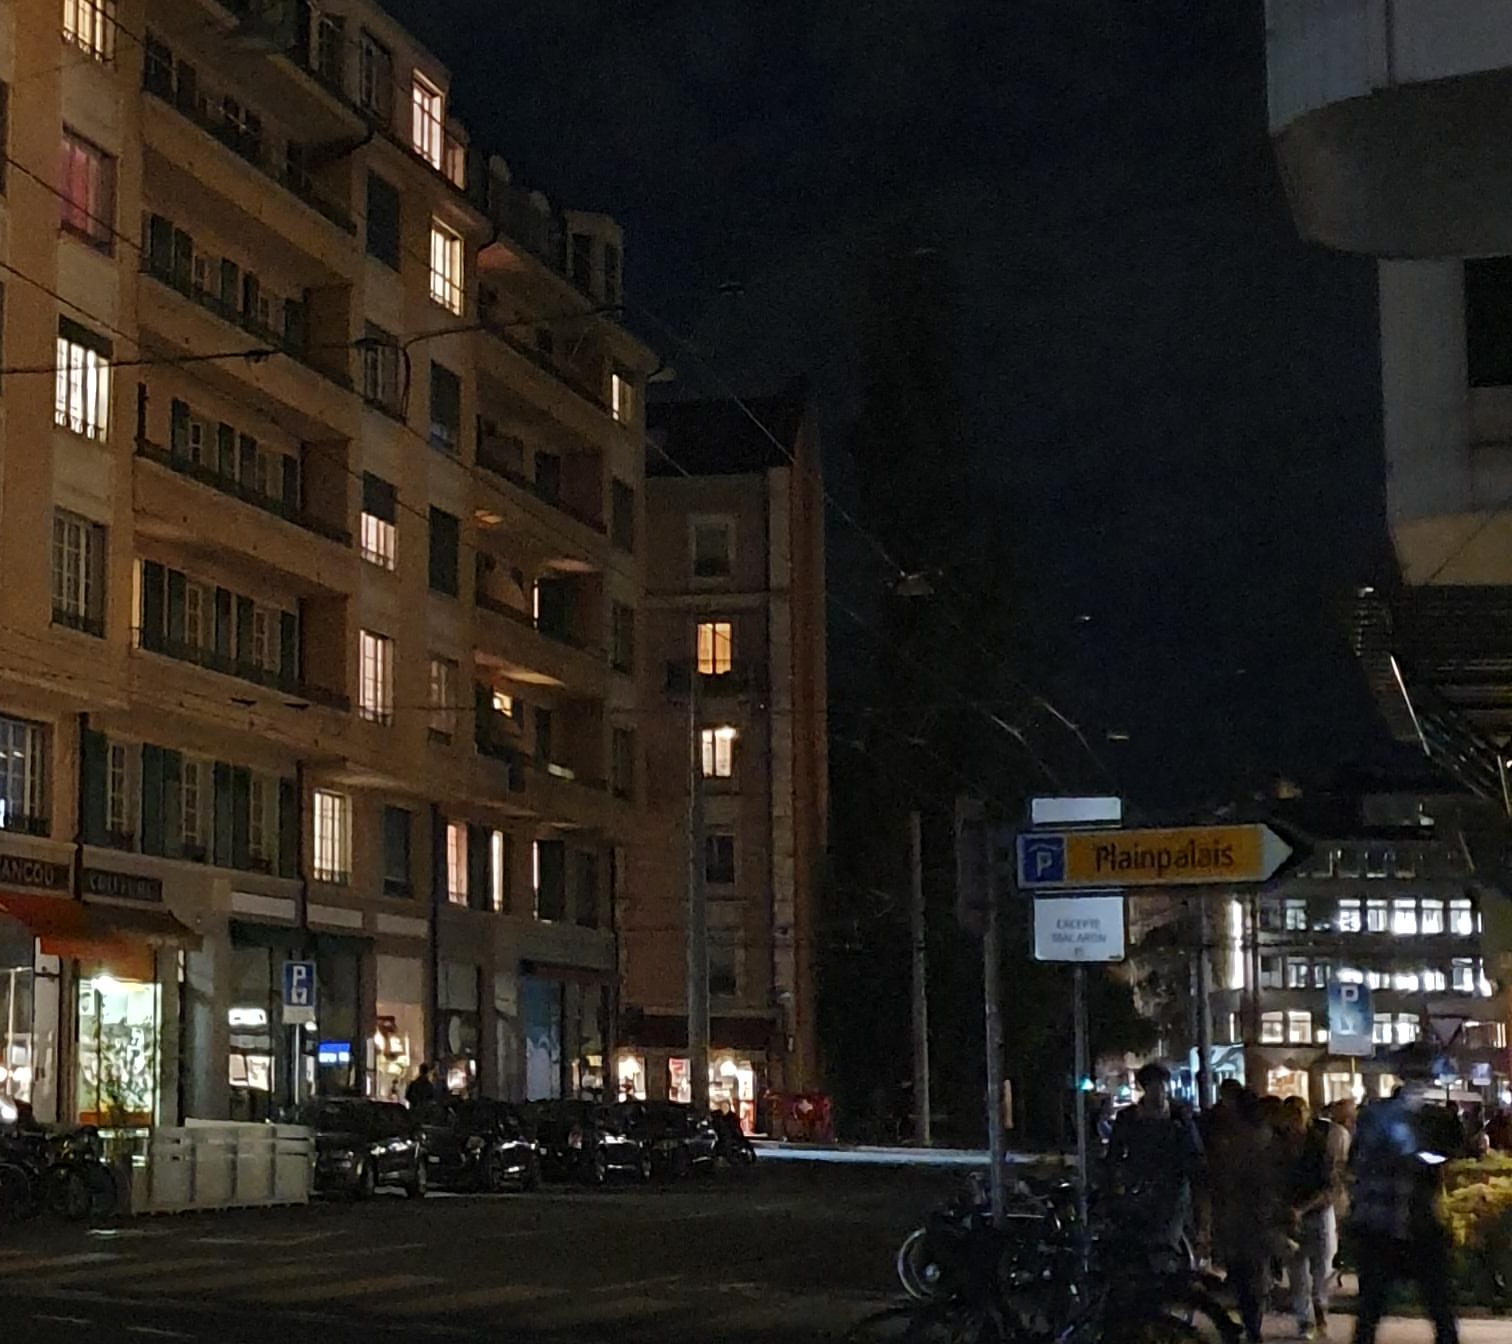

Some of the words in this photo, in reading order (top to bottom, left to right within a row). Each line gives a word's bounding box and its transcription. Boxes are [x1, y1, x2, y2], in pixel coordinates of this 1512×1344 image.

[1035, 850, 1053, 878] P
[1095, 838, 1236, 877] Plainpalais
[292, 965, 307, 988] P
